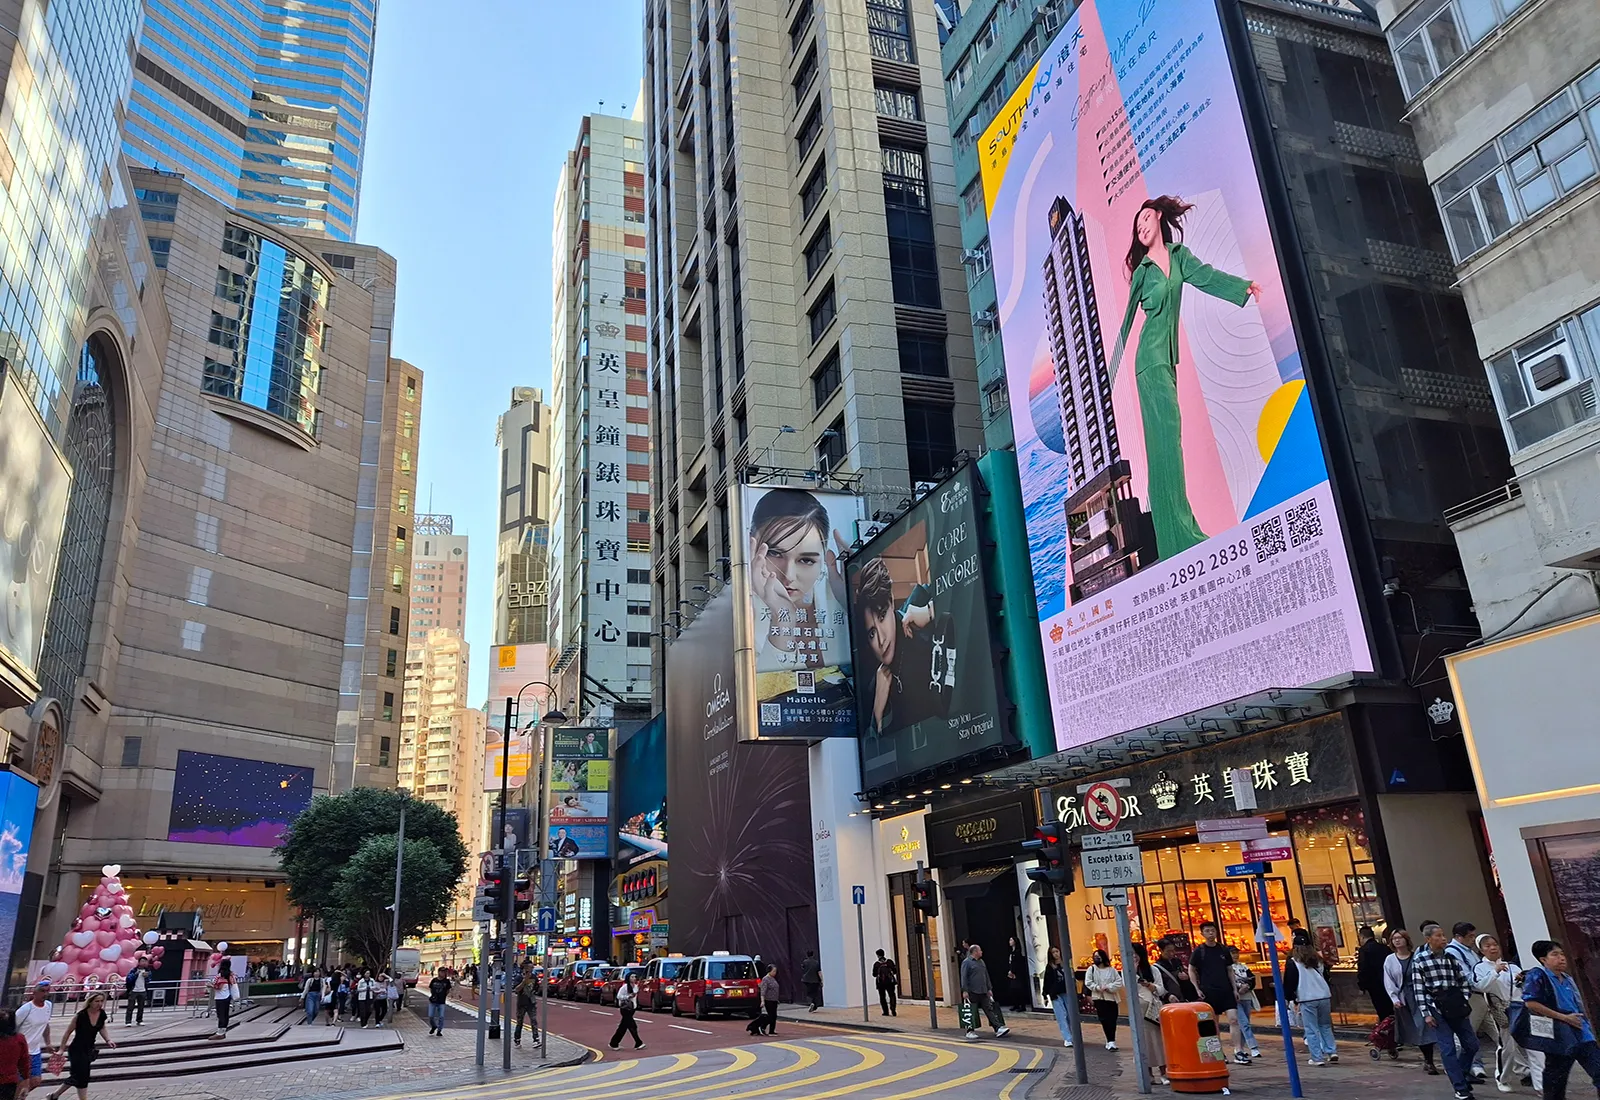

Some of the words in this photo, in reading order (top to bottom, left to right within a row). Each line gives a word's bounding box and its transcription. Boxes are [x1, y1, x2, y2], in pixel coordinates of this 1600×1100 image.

[1056, 25, 1085, 68] 澄天
[1118, 30, 1157, 82] 近在咫尺
[595, 352, 620, 643] 英皇鐘錶珠寶中心
[937, 521, 967, 556] CORE
[935, 553, 979, 596] ENCORE
[1169, 559, 1206, 589] 2892
[1208, 539, 1249, 571] 2838
[1180, 563, 1252, 605] 英皇集團中心2樓
[706, 688, 731, 718] OMEGA
[786, 696, 827, 704] MaBelle
[1057, 795, 1143, 833] EMOR
[1122, 833, 1131, 842] 12
[1088, 854, 1113, 864] Except
[1114, 852, 1134, 862] taxis
[1091, 866, 1133, 881] 的士例外
[1324, 880, 1377, 905] SALE
[1084, 903, 1115, 922] SALE
